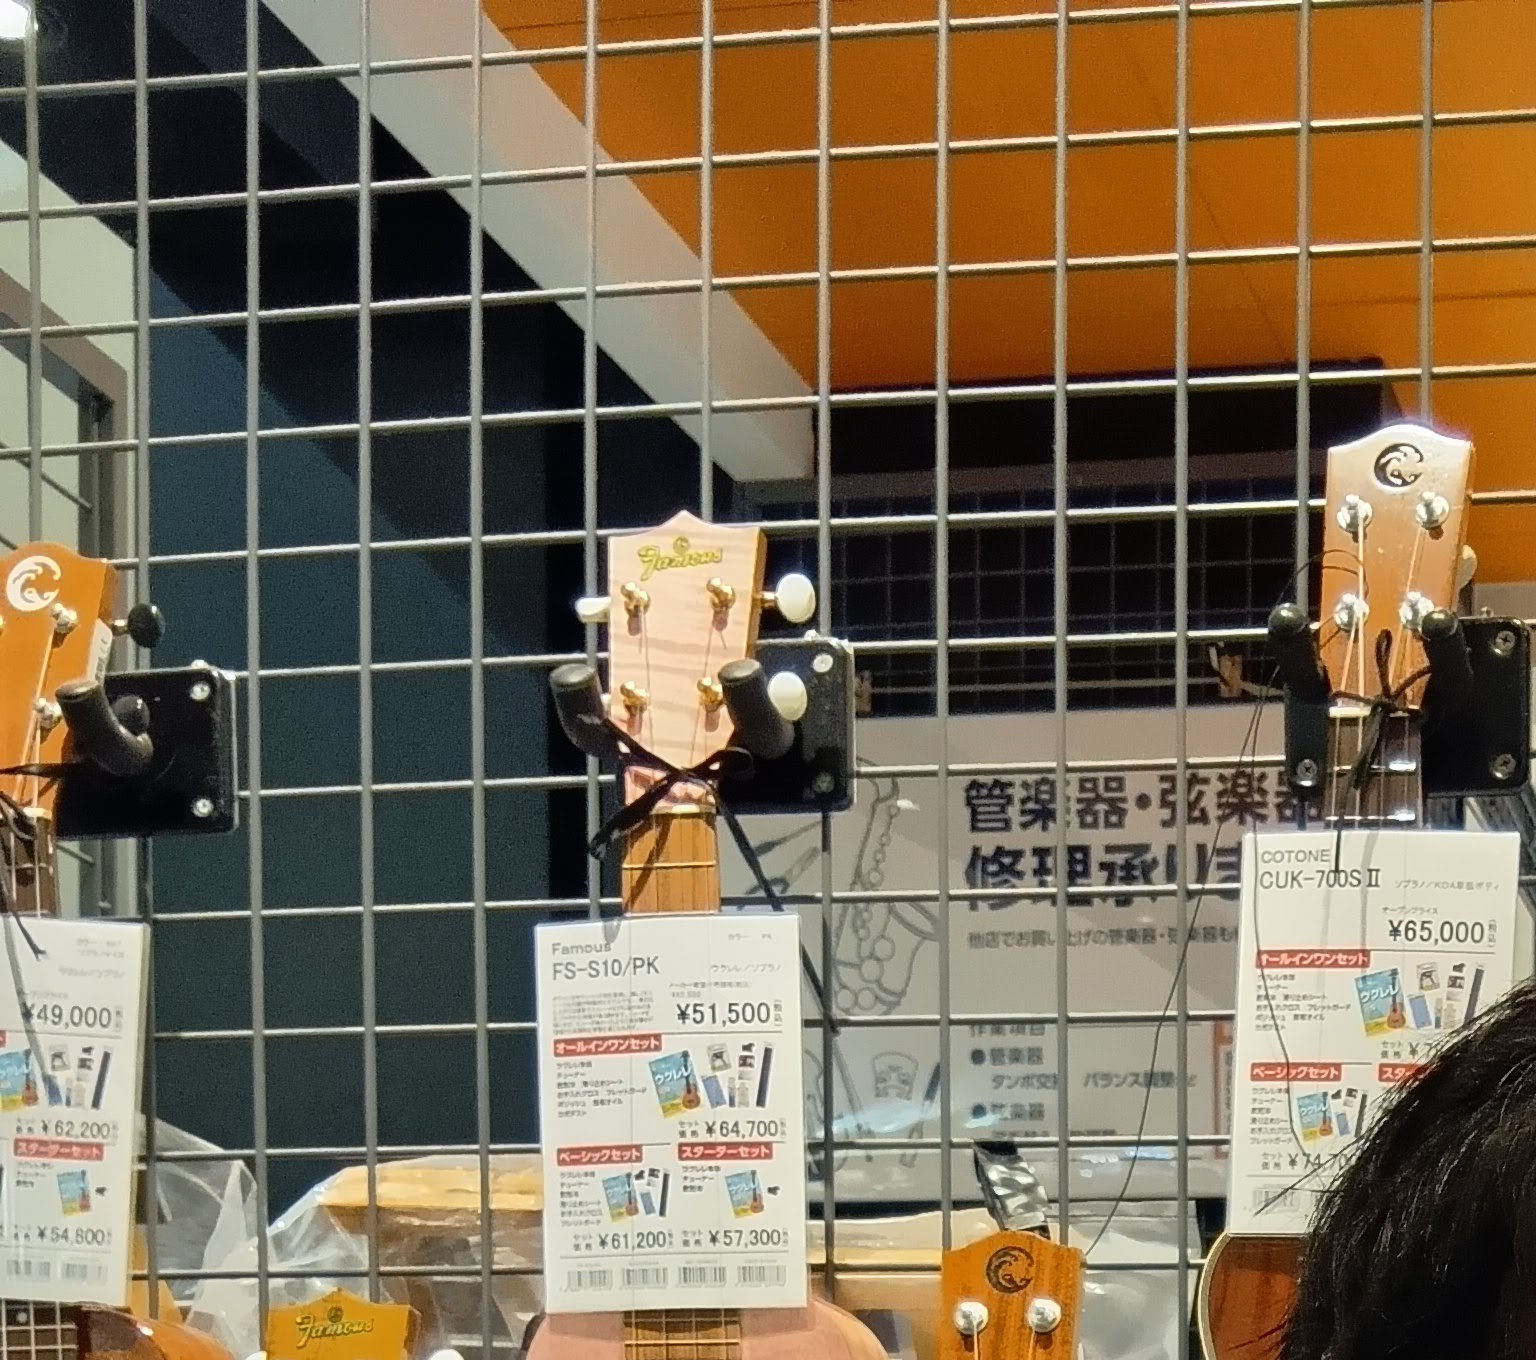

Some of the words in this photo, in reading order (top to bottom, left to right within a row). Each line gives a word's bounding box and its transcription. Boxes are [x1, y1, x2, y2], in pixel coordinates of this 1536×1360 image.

[1261, 849, 1330, 863] COTONE
[1389, 920, 1484, 946] ¥65,000
[552, 943, 611, 955] Famous
[1260, 952, 1368, 966] オールインワンセット
[553, 956, 660, 980] FS-S10/PK
[677, 1002, 770, 1027] ¥51,500
[555, 1037, 660, 1054] オールインワンセット
[654, 1067, 692, 1084] ウクレレ
[1252, 1066, 1338, 1079] ベーシックセット
[705, 1120, 778, 1139] ¥64,700
[559, 1147, 640, 1163] ベーシックセット
[681, 1144, 770, 1158] スターターセット
[598, 1230, 667, 1250] ¥61,200
[709, 1229, 781, 1247] ¥57,300
[296, 1315, 374, 1348] Famous
